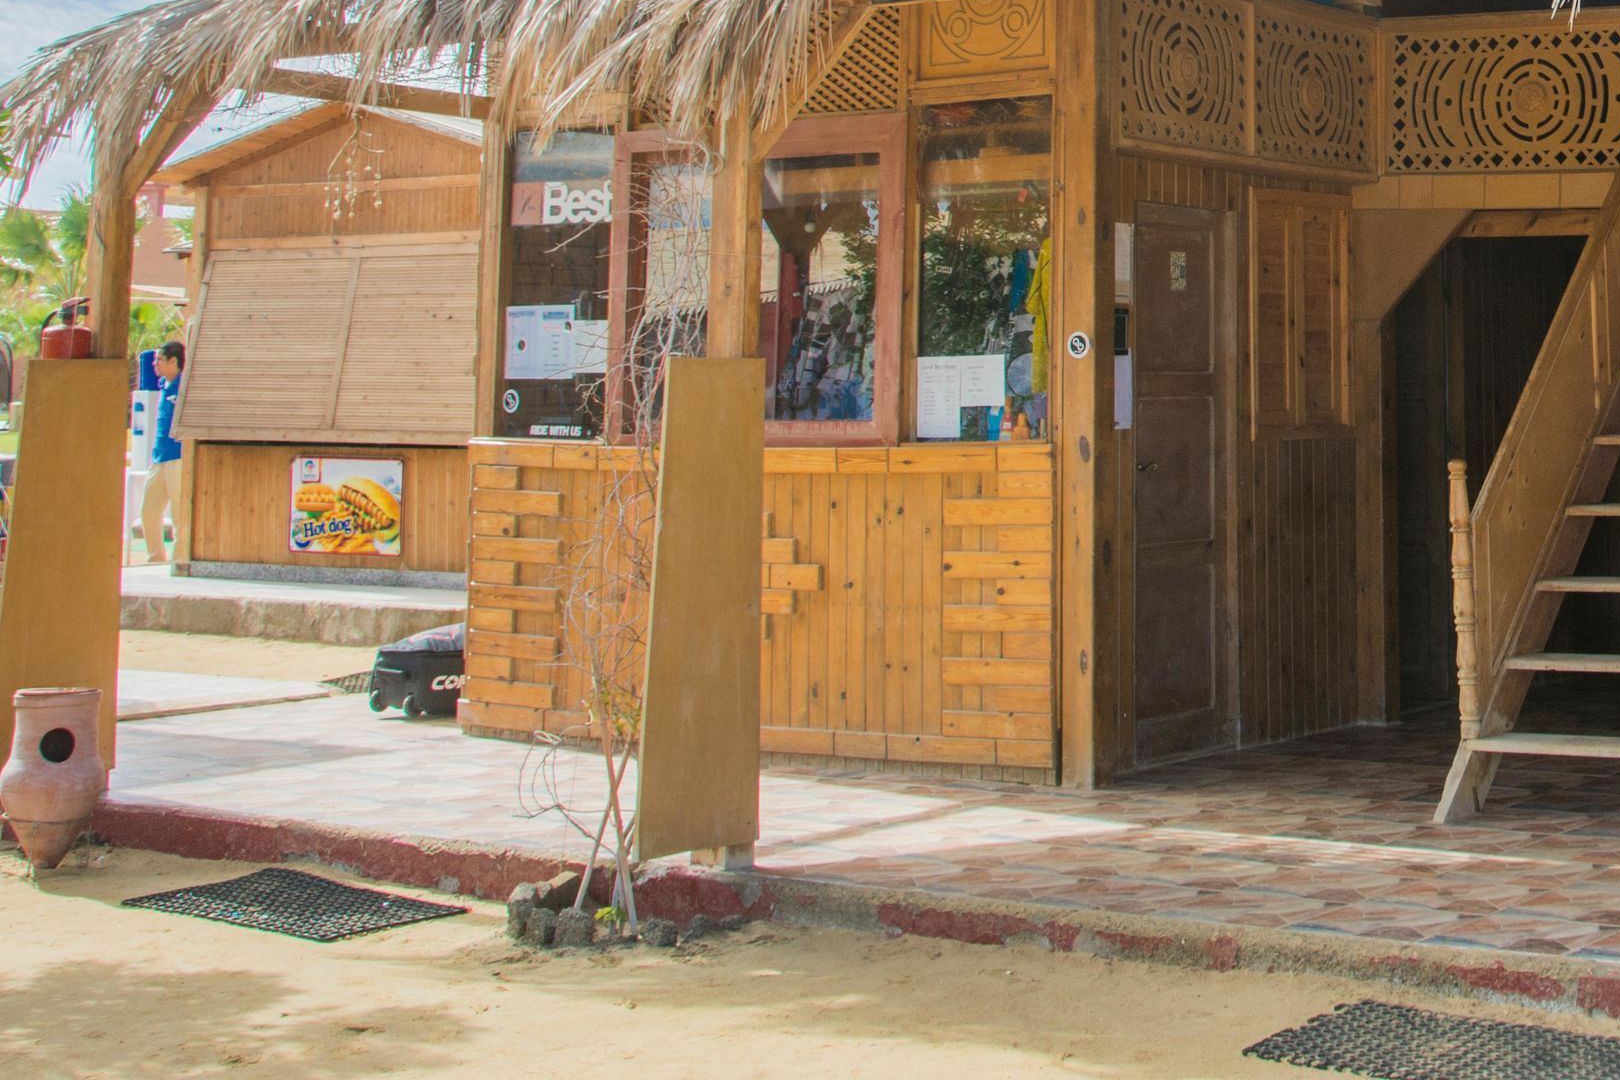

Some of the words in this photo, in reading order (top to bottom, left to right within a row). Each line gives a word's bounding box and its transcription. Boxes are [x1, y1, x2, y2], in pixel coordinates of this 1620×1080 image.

[529, 424, 549, 436] RIDE
[549, 424, 570, 437] WITH
[570, 425, 583, 437] US
[303, 521, 325, 538] Hot
[328, 517, 352, 534] dog
